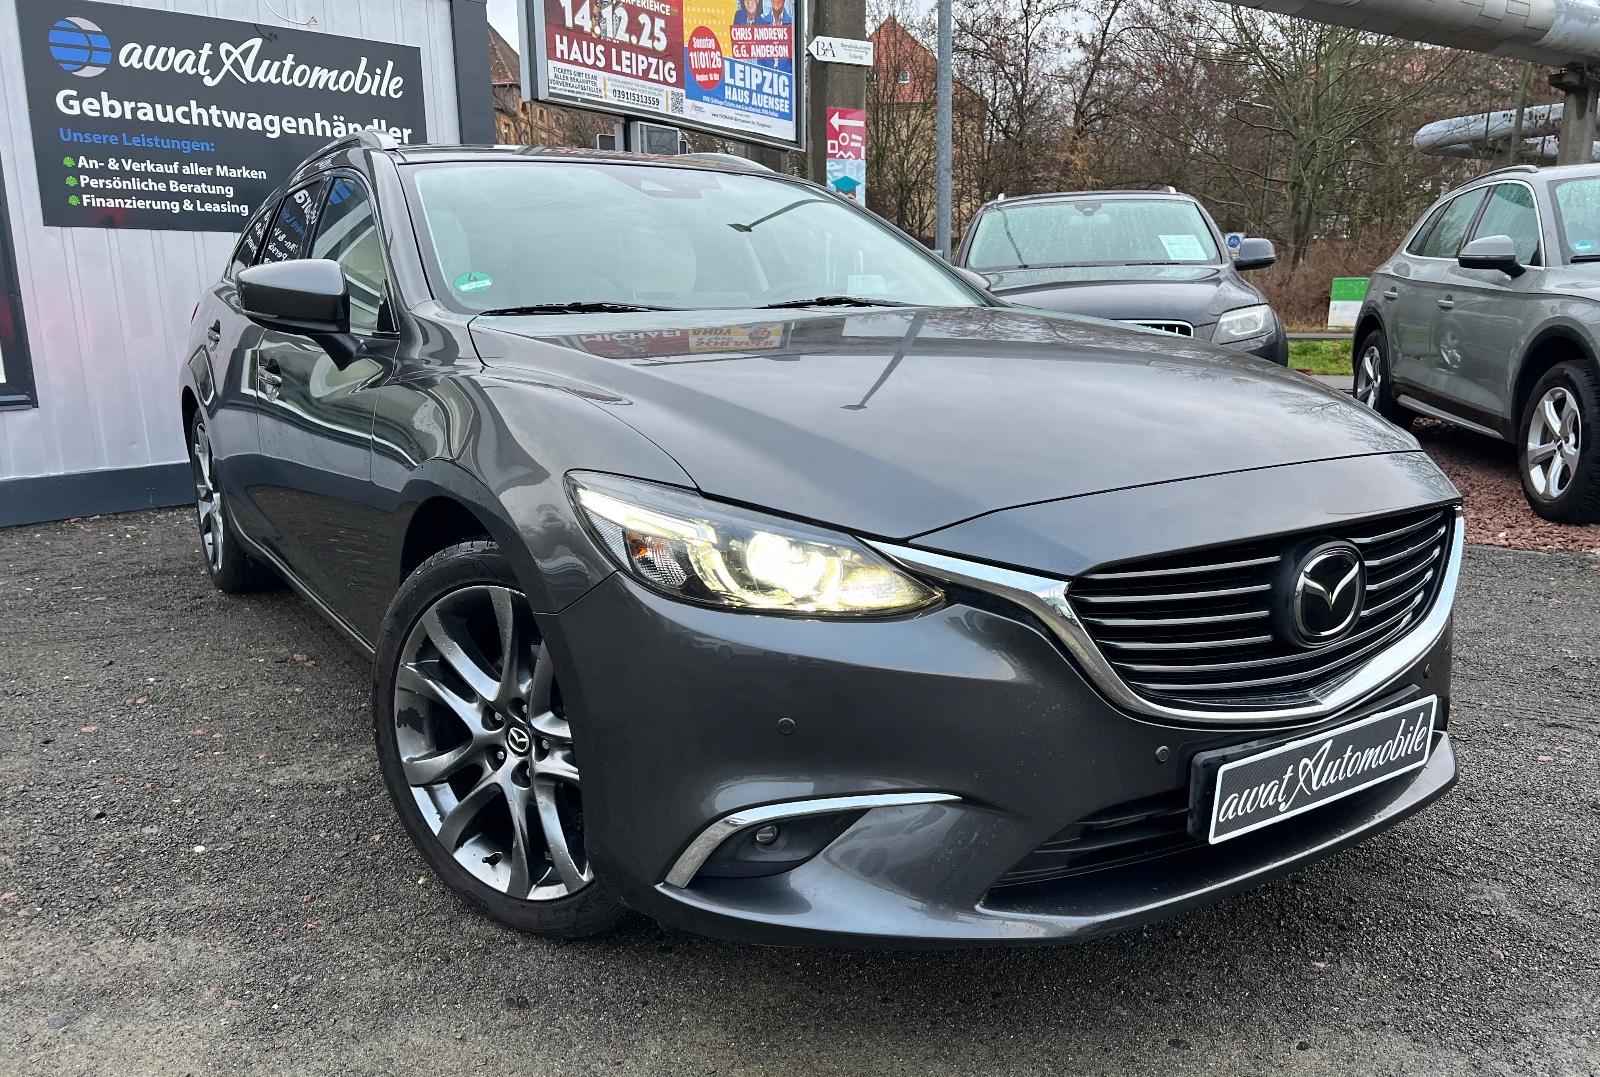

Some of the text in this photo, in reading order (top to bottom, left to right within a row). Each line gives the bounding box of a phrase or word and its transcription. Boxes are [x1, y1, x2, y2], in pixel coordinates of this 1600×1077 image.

[620, 0, 671, 16] PERIENCE
[560, 0, 668, 51] 14.12.25
[731, 27, 788, 41] CHRIS ANDREWS
[555, 34, 677, 84] HAUS LEIPZIG
[732, 44, 789, 58] G.G. ANDERSON
[553, 66, 573, 76] TICKETS
[573, 70, 584, 78] GIBT
[724, 59, 789, 98] LEIPZIG
[724, 85, 750, 104] HAUS
[751, 92, 790, 113] AUENSEE
[59, 127, 215, 153] Unsere Leistungen:
[77, 155, 267, 180] An- & Verkauf aller Marken
[79, 174, 234, 198] Persönliche Beratung
[82, 193, 249, 217] Finanzierung & Leasing
